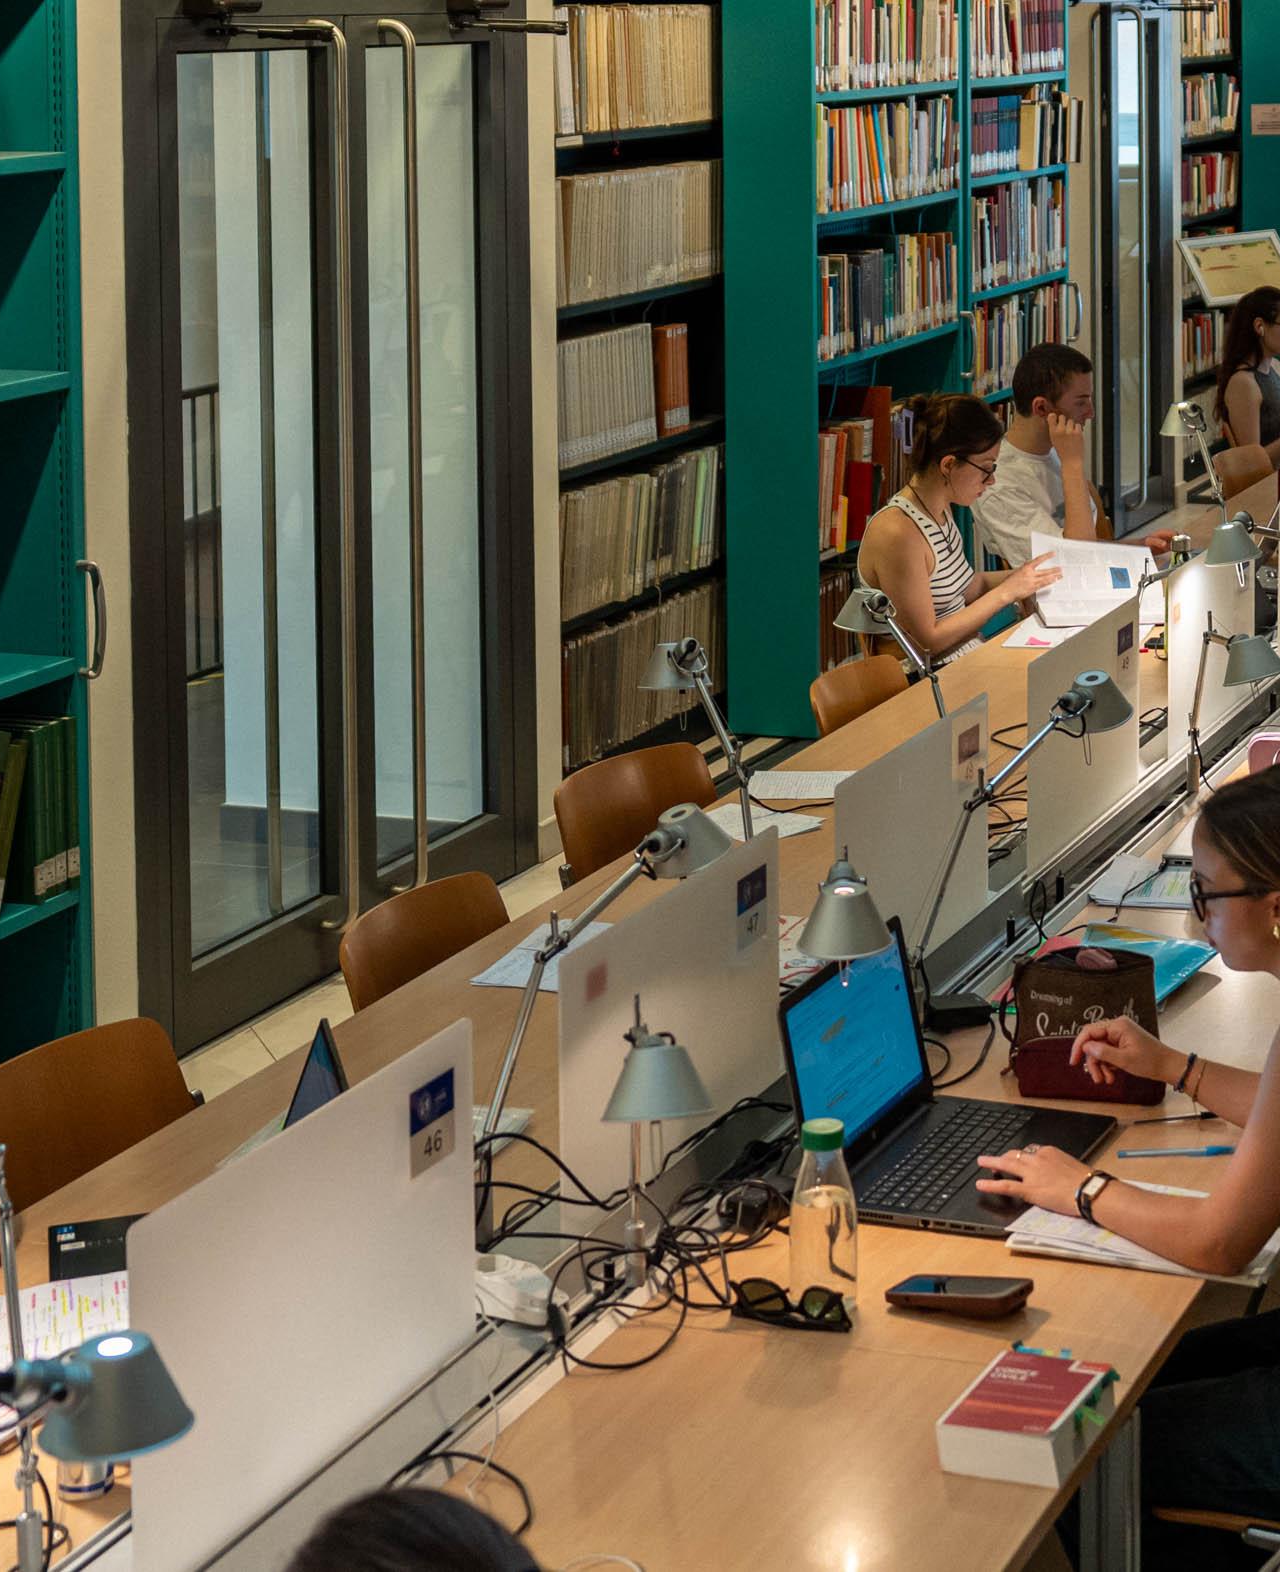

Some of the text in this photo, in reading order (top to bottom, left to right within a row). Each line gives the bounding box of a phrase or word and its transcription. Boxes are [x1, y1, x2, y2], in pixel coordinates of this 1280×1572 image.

[747, 912, 759, 936] 47
[1030, 990, 1073, 1006] Dreaming of
[424, 1129, 442, 1157] 46
